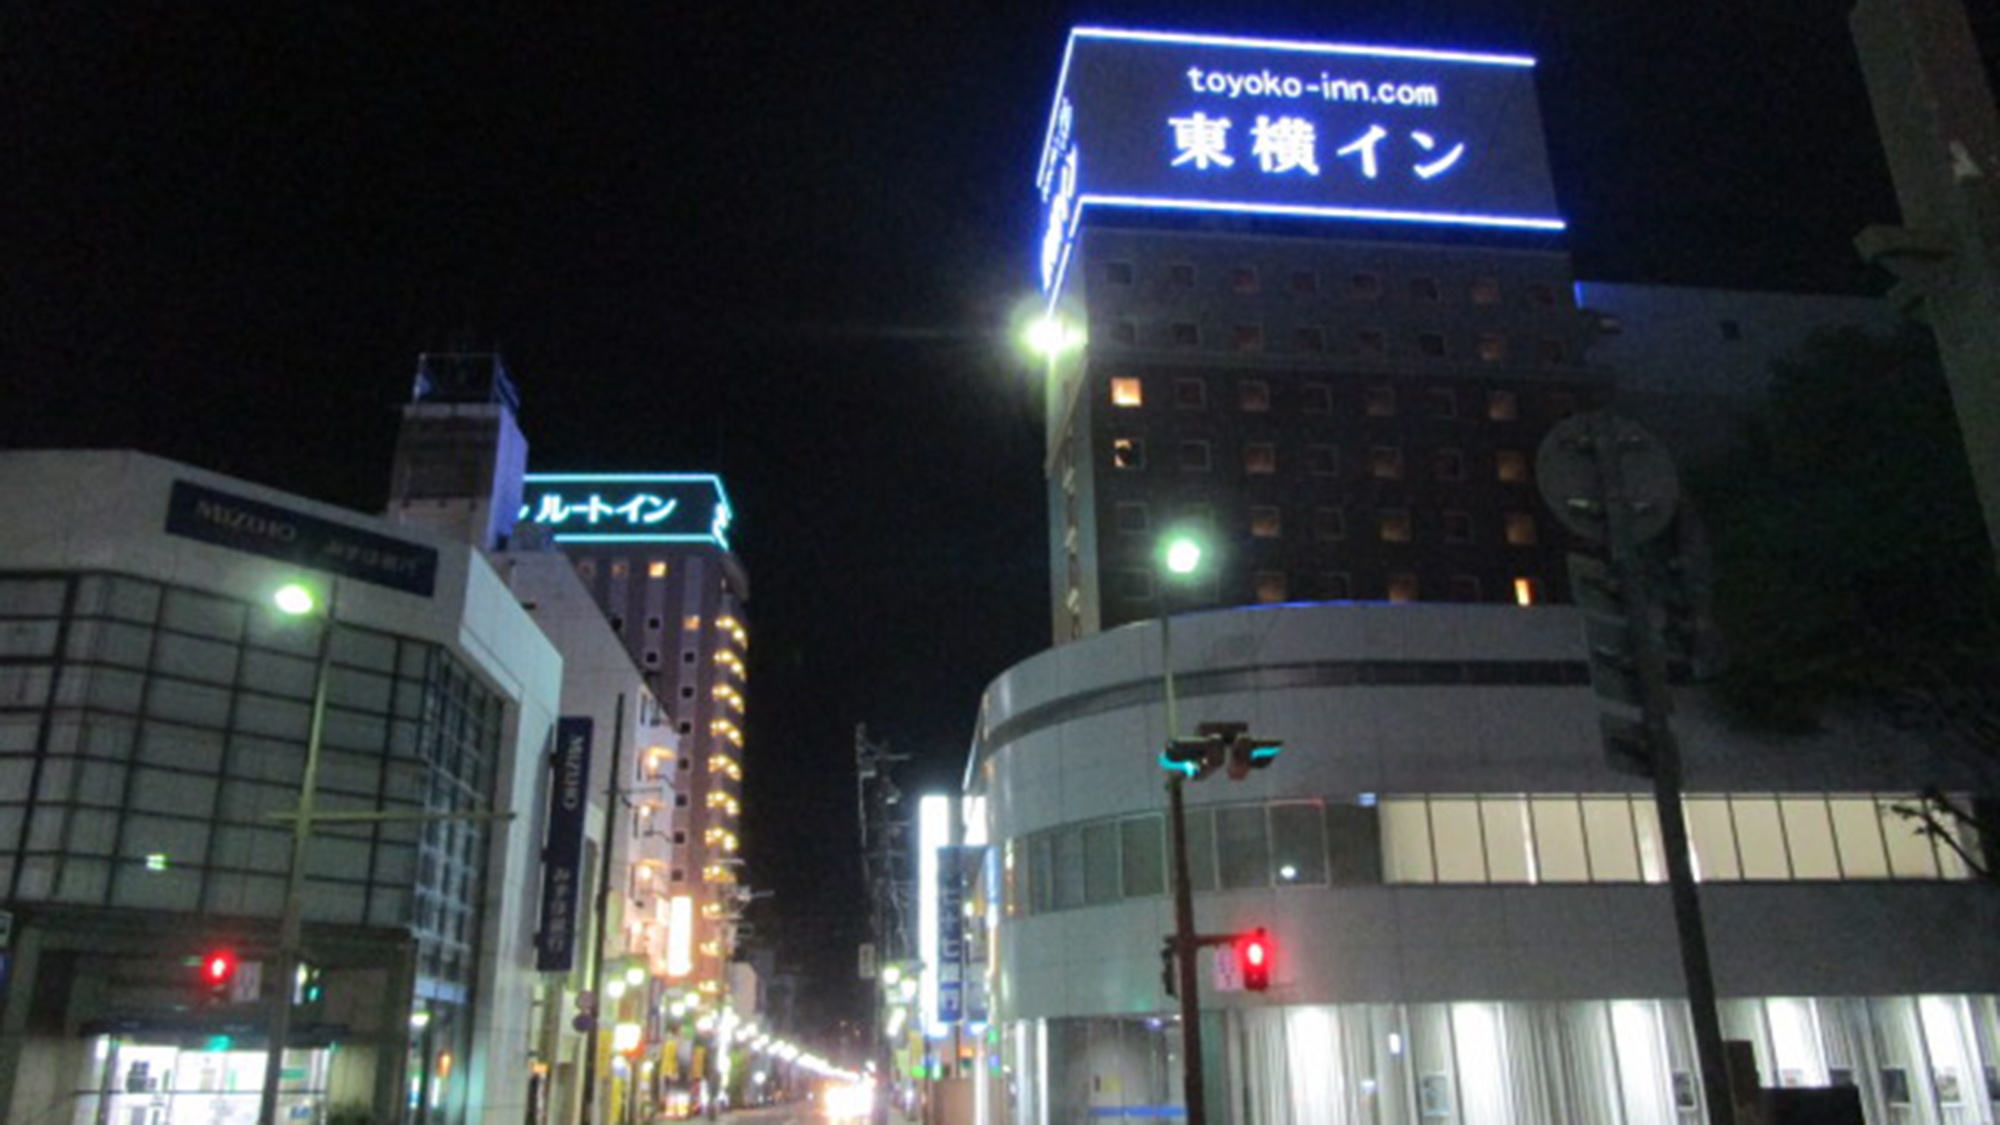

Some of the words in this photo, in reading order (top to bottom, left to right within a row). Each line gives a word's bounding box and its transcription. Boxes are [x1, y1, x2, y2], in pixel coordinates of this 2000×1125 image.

[1187, 66, 1438, 106] toyoko-inn.com
[1167, 111, 1464, 178] 東横イン
[518, 493, 679, 525] ルートイン
